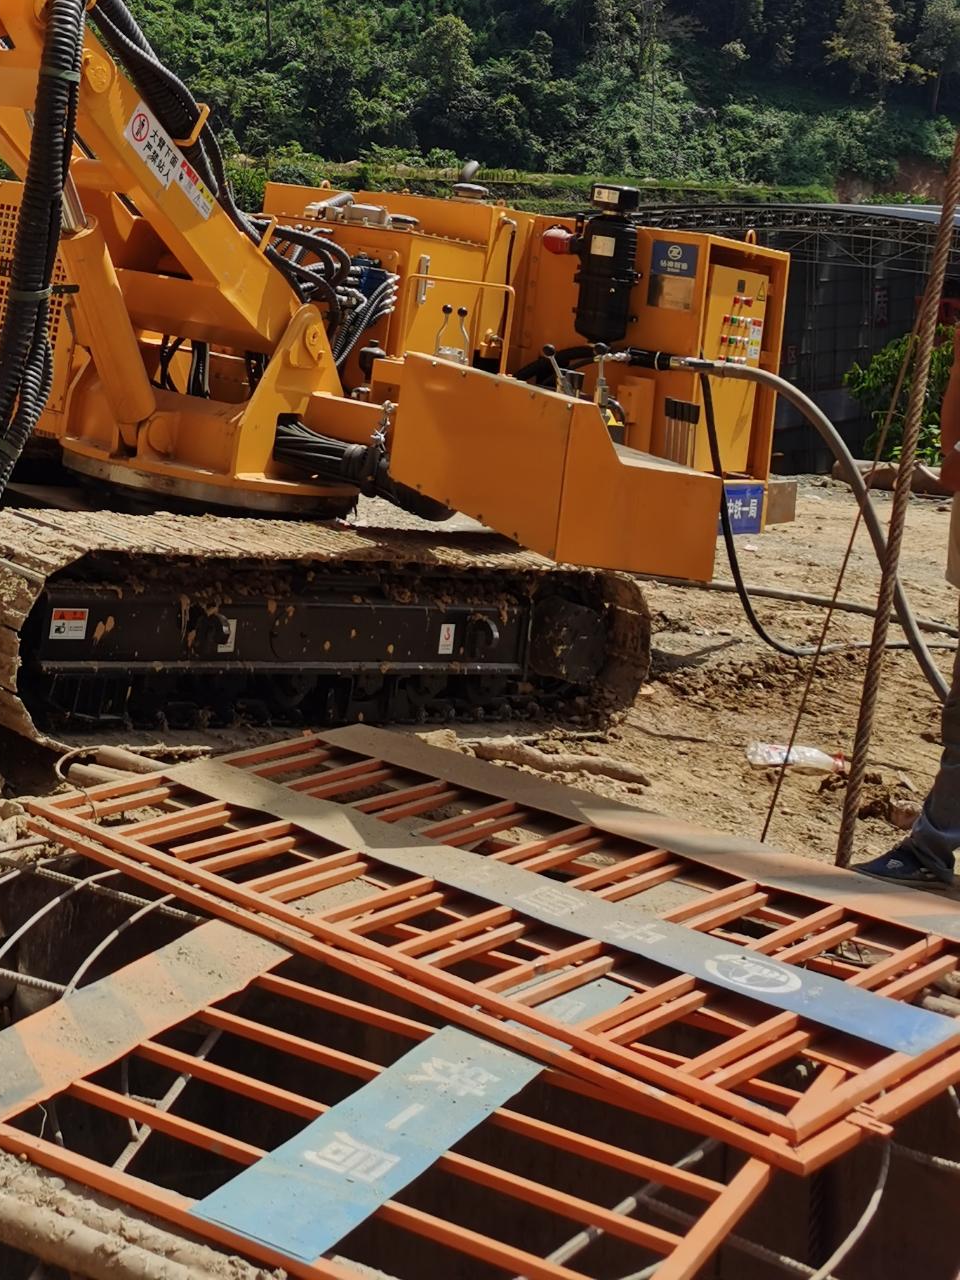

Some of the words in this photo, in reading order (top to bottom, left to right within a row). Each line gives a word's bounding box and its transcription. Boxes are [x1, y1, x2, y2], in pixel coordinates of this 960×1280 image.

[143, 141, 171, 182] 严禁站人
[150, 129, 179, 168] 大臂下面
[303, 1057, 502, 1183] 铁一局
